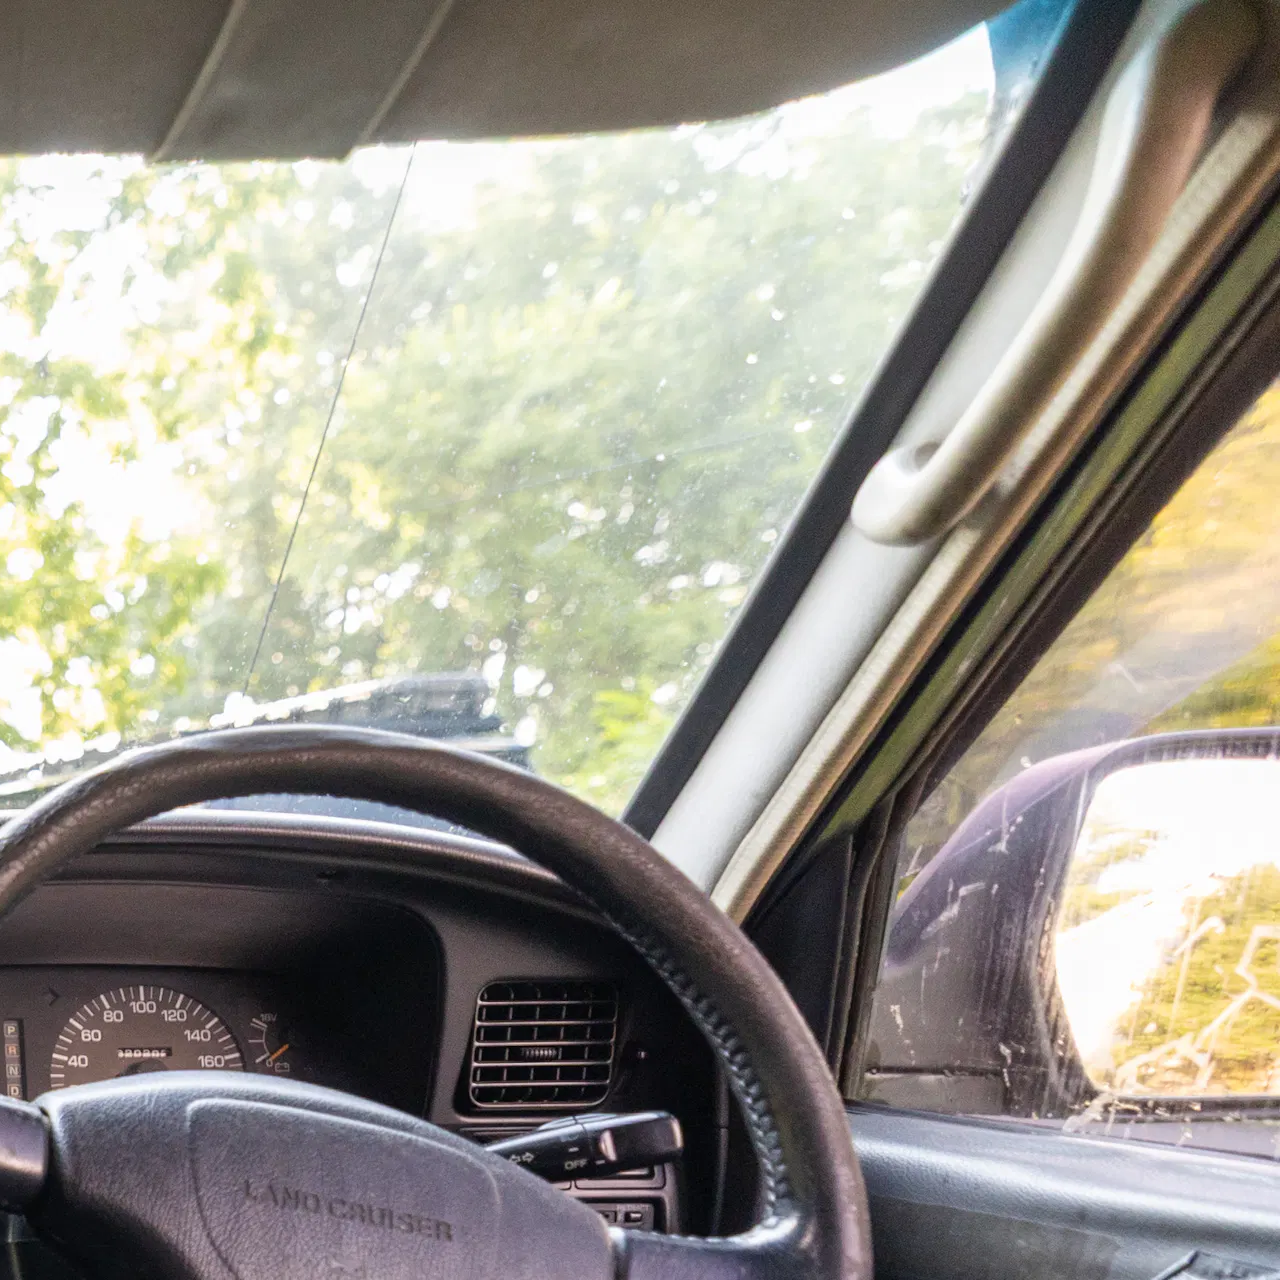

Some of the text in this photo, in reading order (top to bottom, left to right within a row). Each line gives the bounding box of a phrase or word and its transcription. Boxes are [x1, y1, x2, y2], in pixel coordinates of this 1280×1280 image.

[129, 1001, 157, 1013] 100
[103, 1010, 124, 1022] 80
[161, 1010, 187, 1022] 120
[7, 1026, 16, 1034] P
[81, 1029, 102, 1042] 60
[184, 1029, 211, 1042] 140
[8, 1046, 17, 1055] R
[67, 1055, 89, 1067] 40
[198, 1055, 225, 1067] 160
[9, 1066, 19, 1075] N
[11, 1086, 19, 1096] D
[564, 1159, 587, 1170] OFF
[243, 1179, 452, 1242] LAND CRUISER
